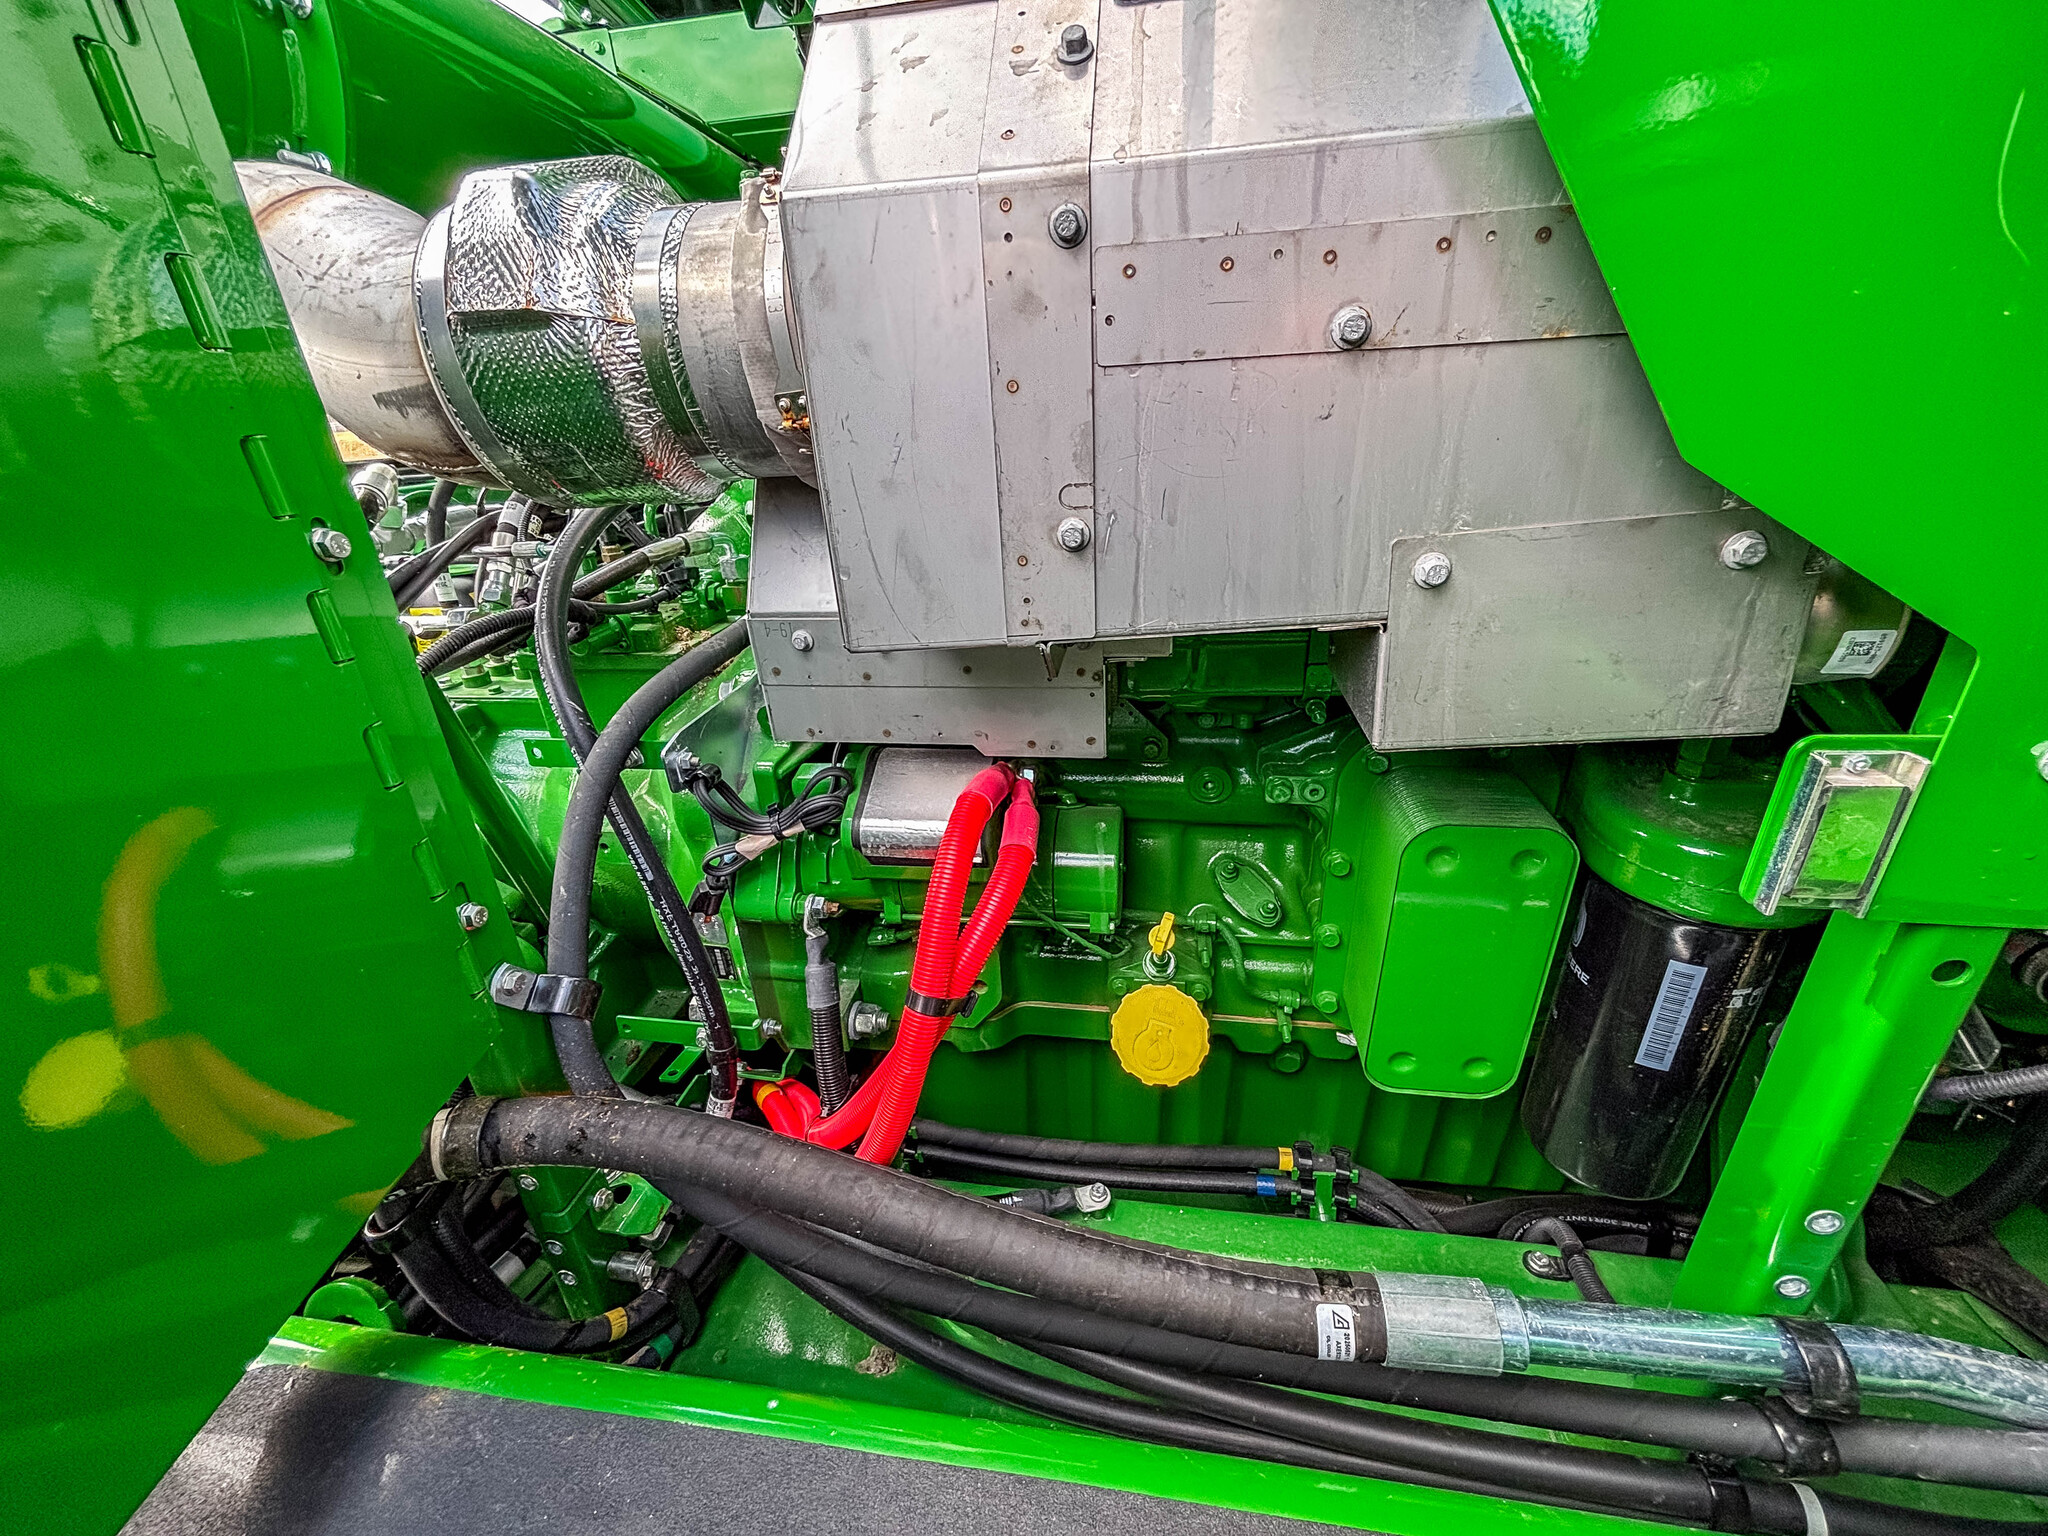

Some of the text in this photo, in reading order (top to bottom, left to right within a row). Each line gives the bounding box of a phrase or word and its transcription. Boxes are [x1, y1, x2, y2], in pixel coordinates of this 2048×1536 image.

[764, 622, 793, 638] 19-4
[541, 680, 558, 716] HEATER
[556, 718, 568, 736] SAE
[627, 854, 637, 870] USA
[635, 868, 644, 880] IN
[639, 879, 654, 902] MADE
